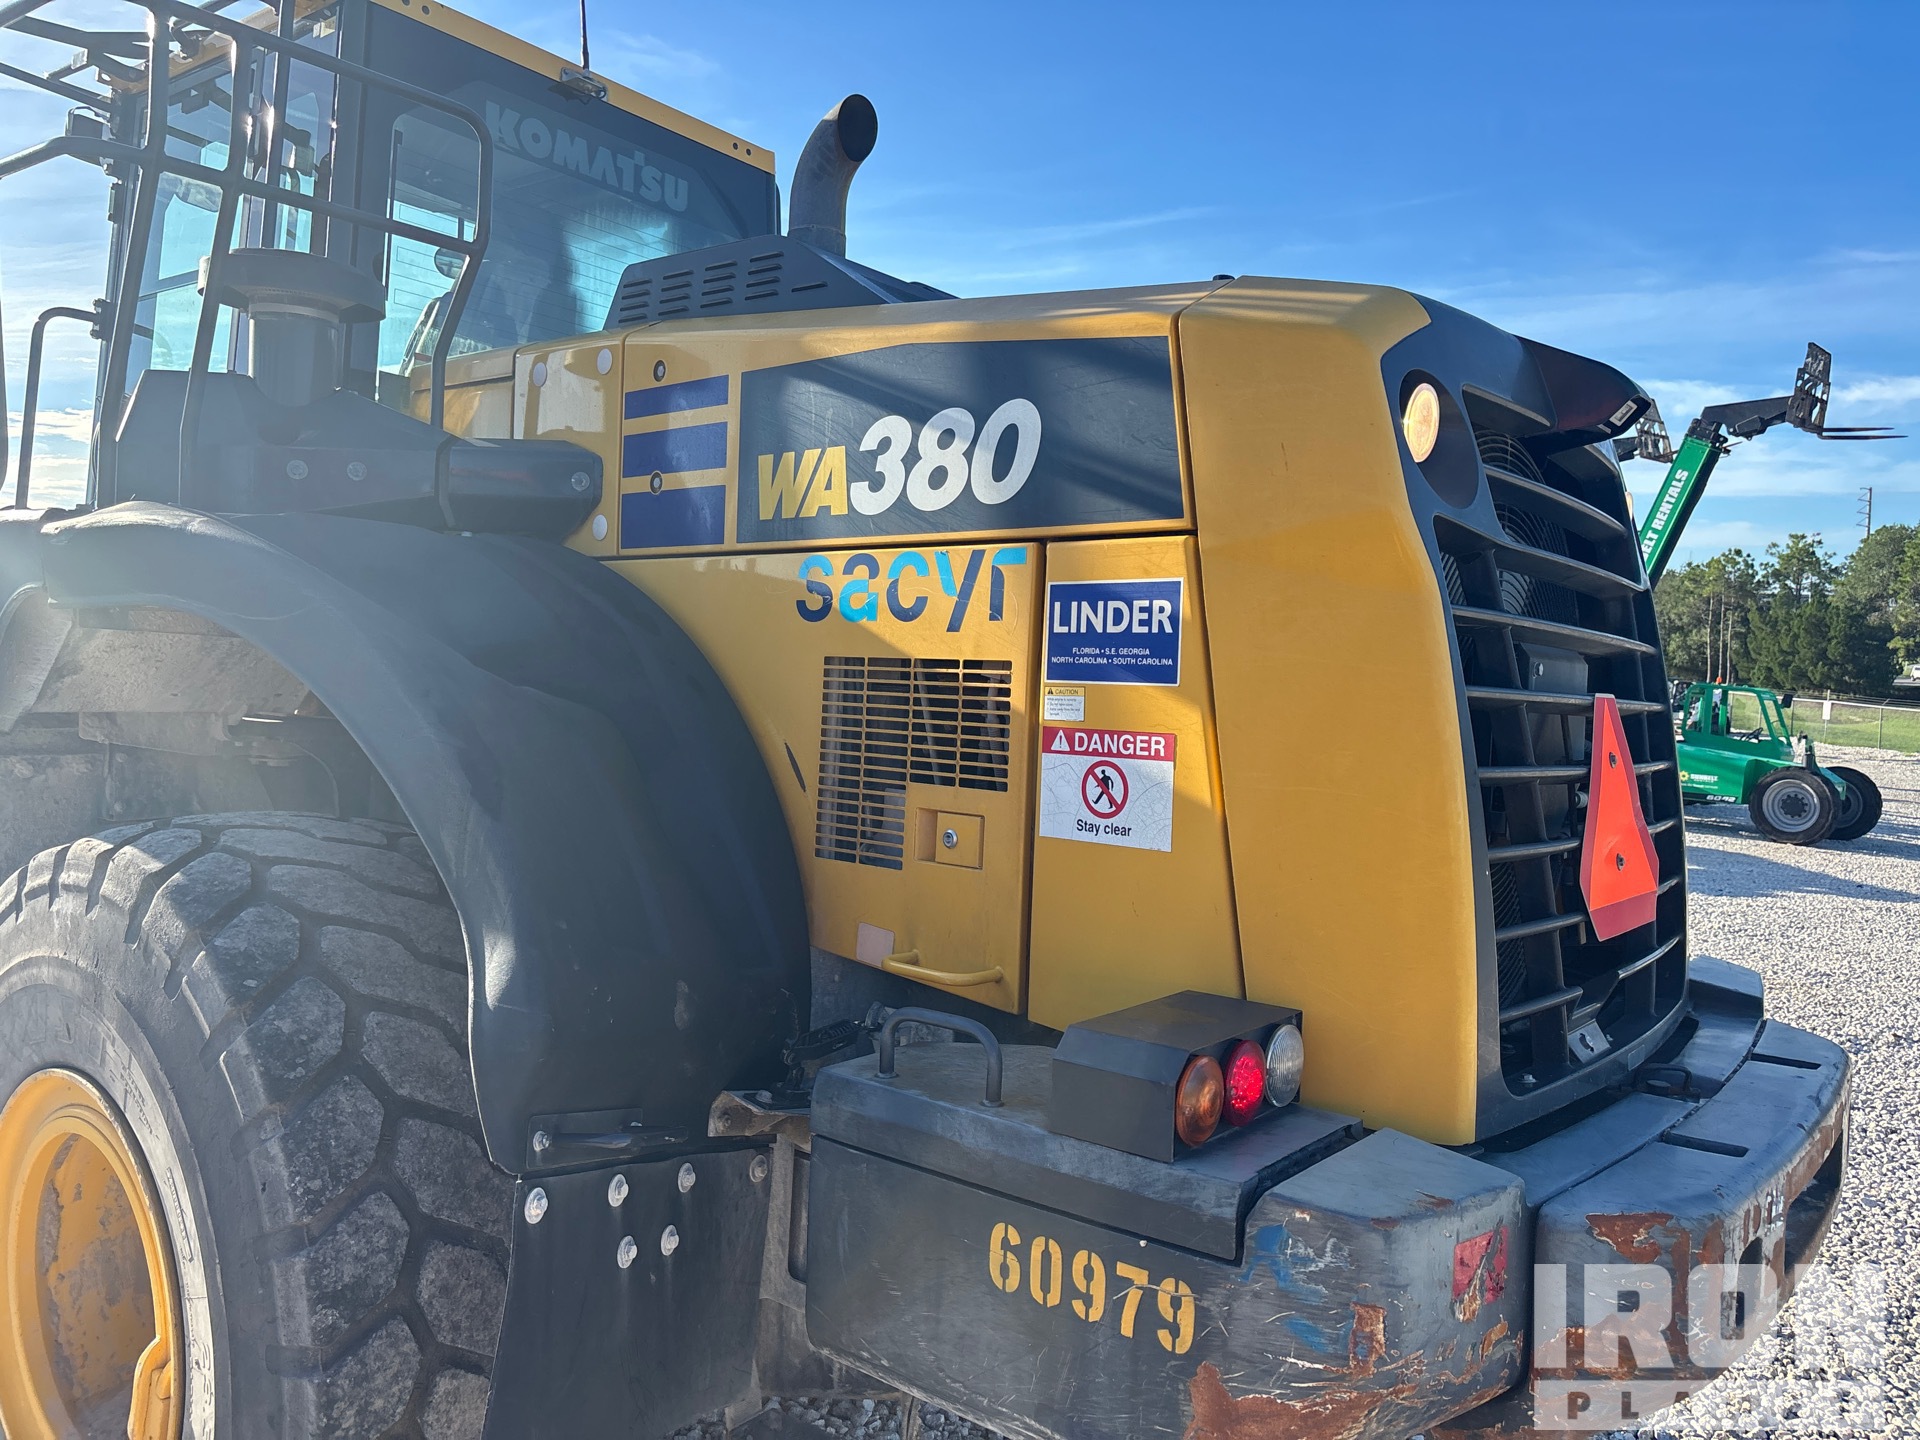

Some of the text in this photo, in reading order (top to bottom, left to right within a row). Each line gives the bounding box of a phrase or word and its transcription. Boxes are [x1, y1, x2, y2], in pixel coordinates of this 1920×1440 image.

[486, 100, 688, 212] KOMATSU
[1651, 469, 1689, 531] RENTALS
[796, 546, 1027, 633] sacyr
[1053, 599, 1173, 634] LINDER
[1051, 656, 1173, 666] NORTH CAROLINA SOUTH CAROLINA
[1072, 647, 1150, 656] FLORIDA S.E. GEORGIA
[1074, 732, 1166, 757] DANGER
[1076, 818, 1132, 837] Stay clear
[988, 1221, 1196, 1355] 60979
